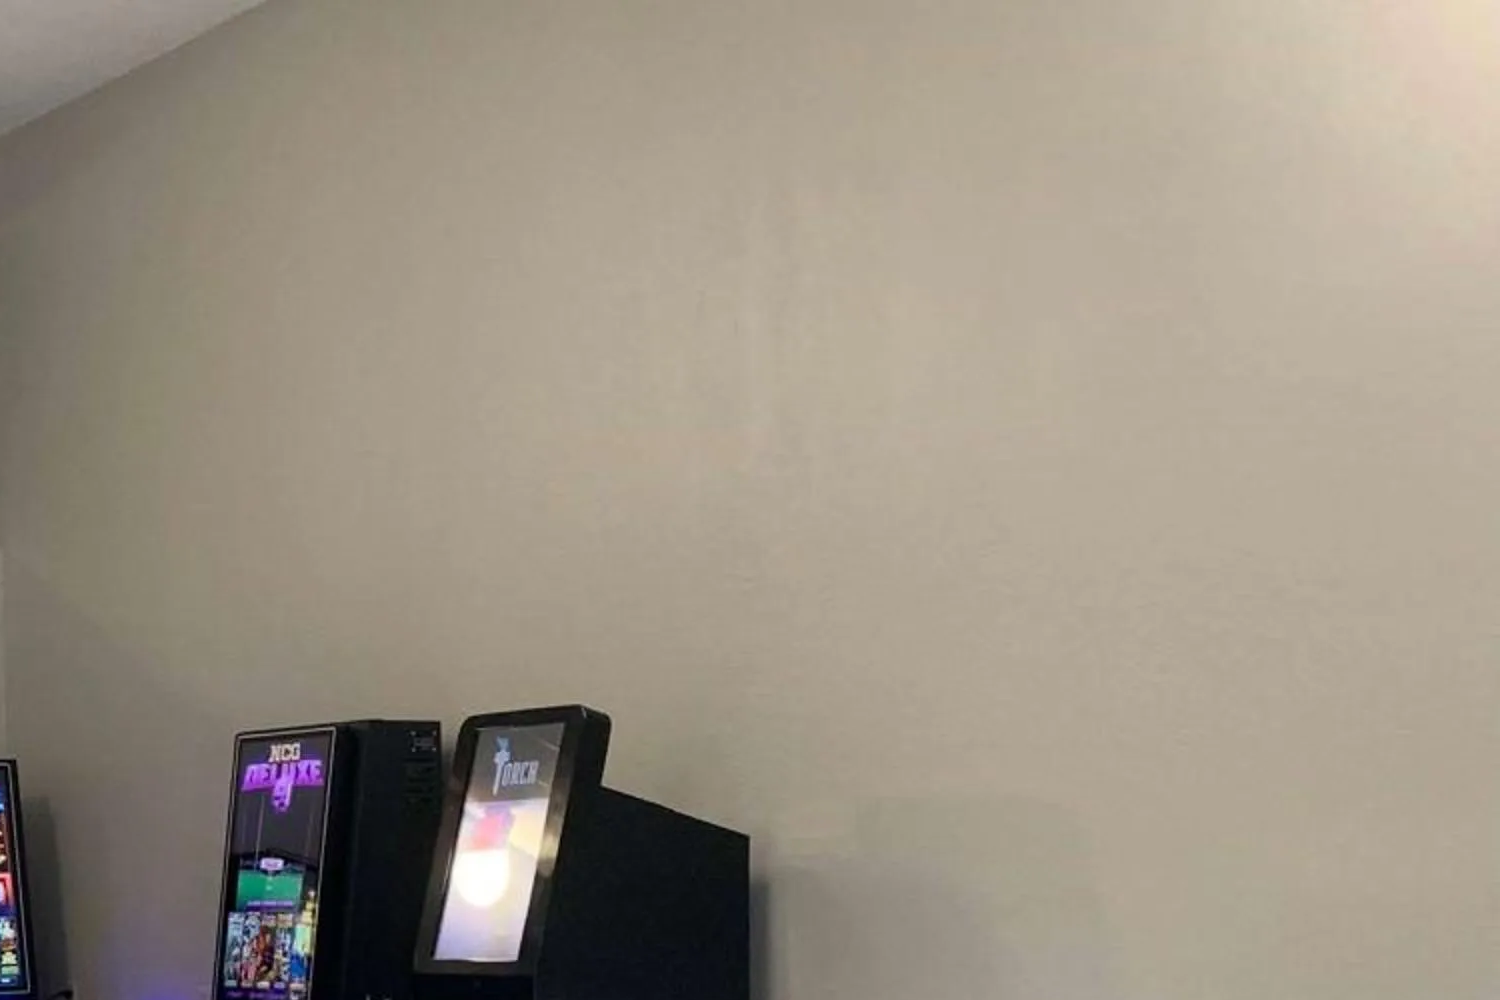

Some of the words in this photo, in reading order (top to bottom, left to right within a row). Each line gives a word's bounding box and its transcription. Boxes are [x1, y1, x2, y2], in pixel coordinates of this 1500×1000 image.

[268, 742, 301, 763] NCG
[241, 759, 325, 793] DELUXE
[492, 748, 540, 797] TORCH
